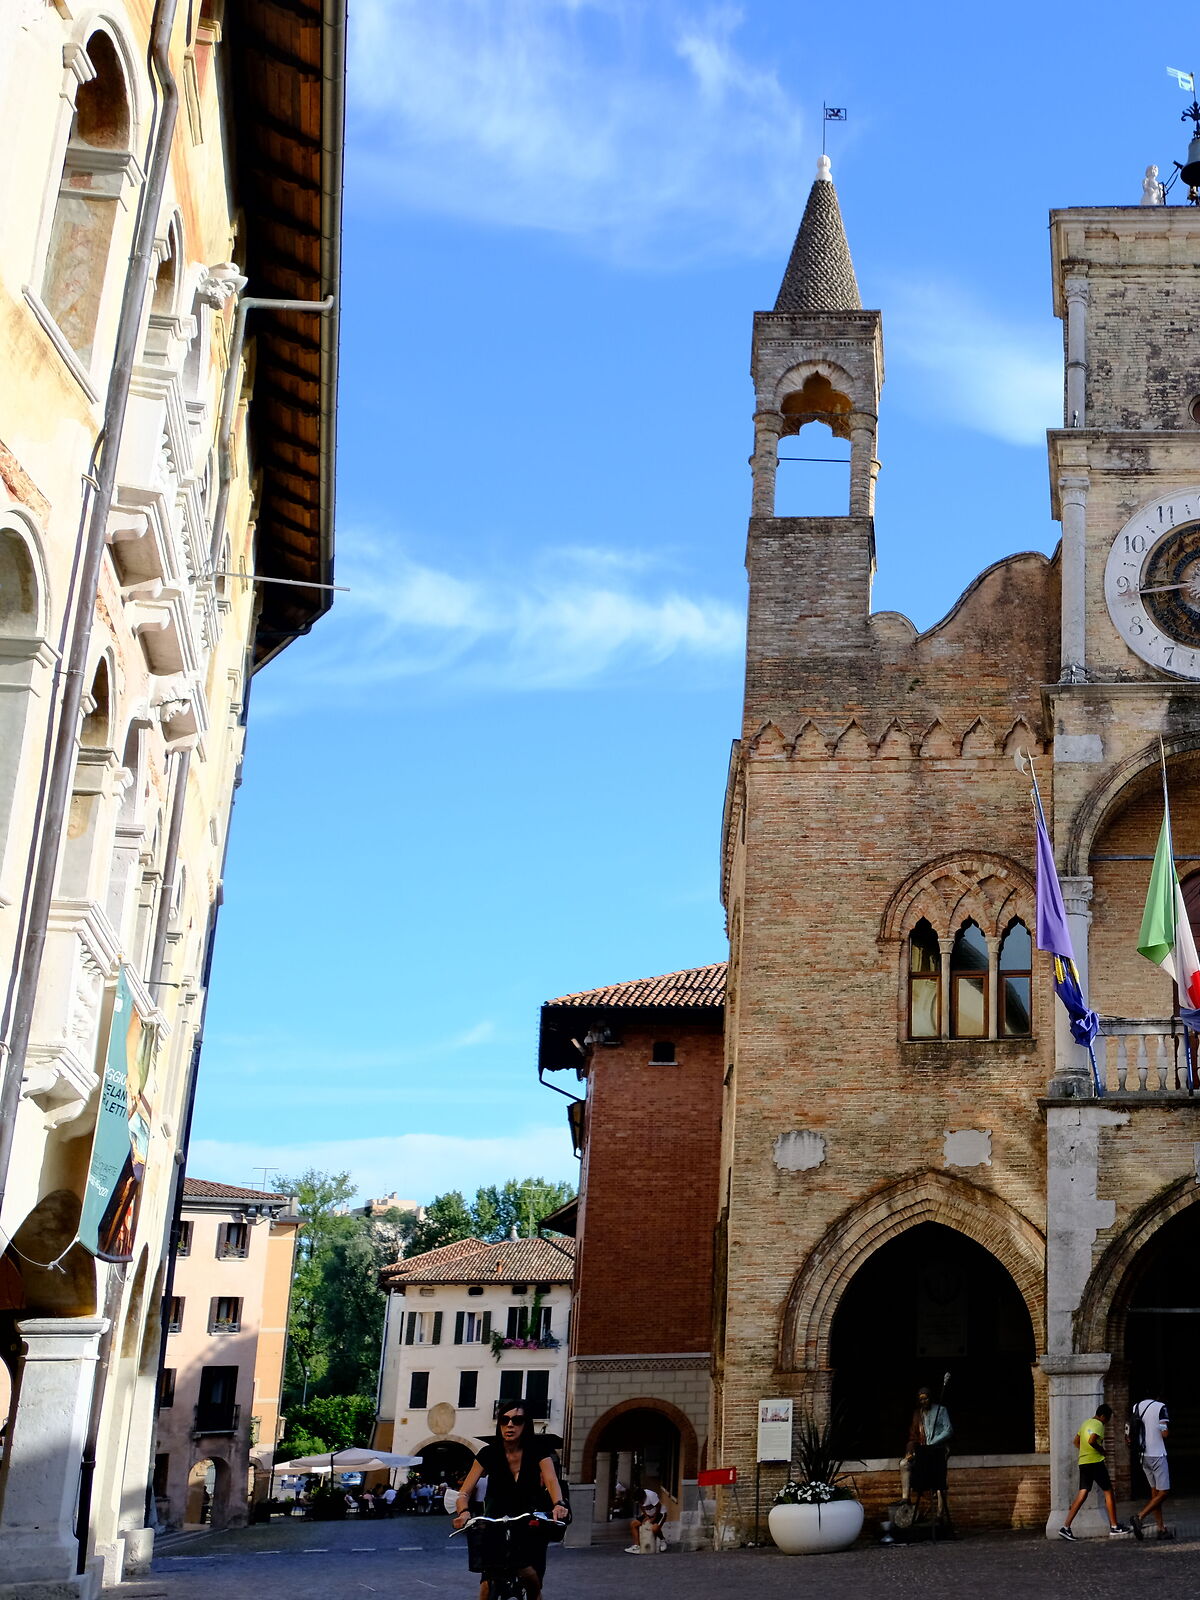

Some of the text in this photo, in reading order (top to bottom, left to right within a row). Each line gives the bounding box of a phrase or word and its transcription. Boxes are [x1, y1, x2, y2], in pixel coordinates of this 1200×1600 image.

[1156, 505, 1174, 523] 11
[1124, 534, 1146, 554] 10
[1116, 575, 1130, 595] 9
[1129, 615, 1144, 636] 8
[1163, 646, 1175, 667] 7
